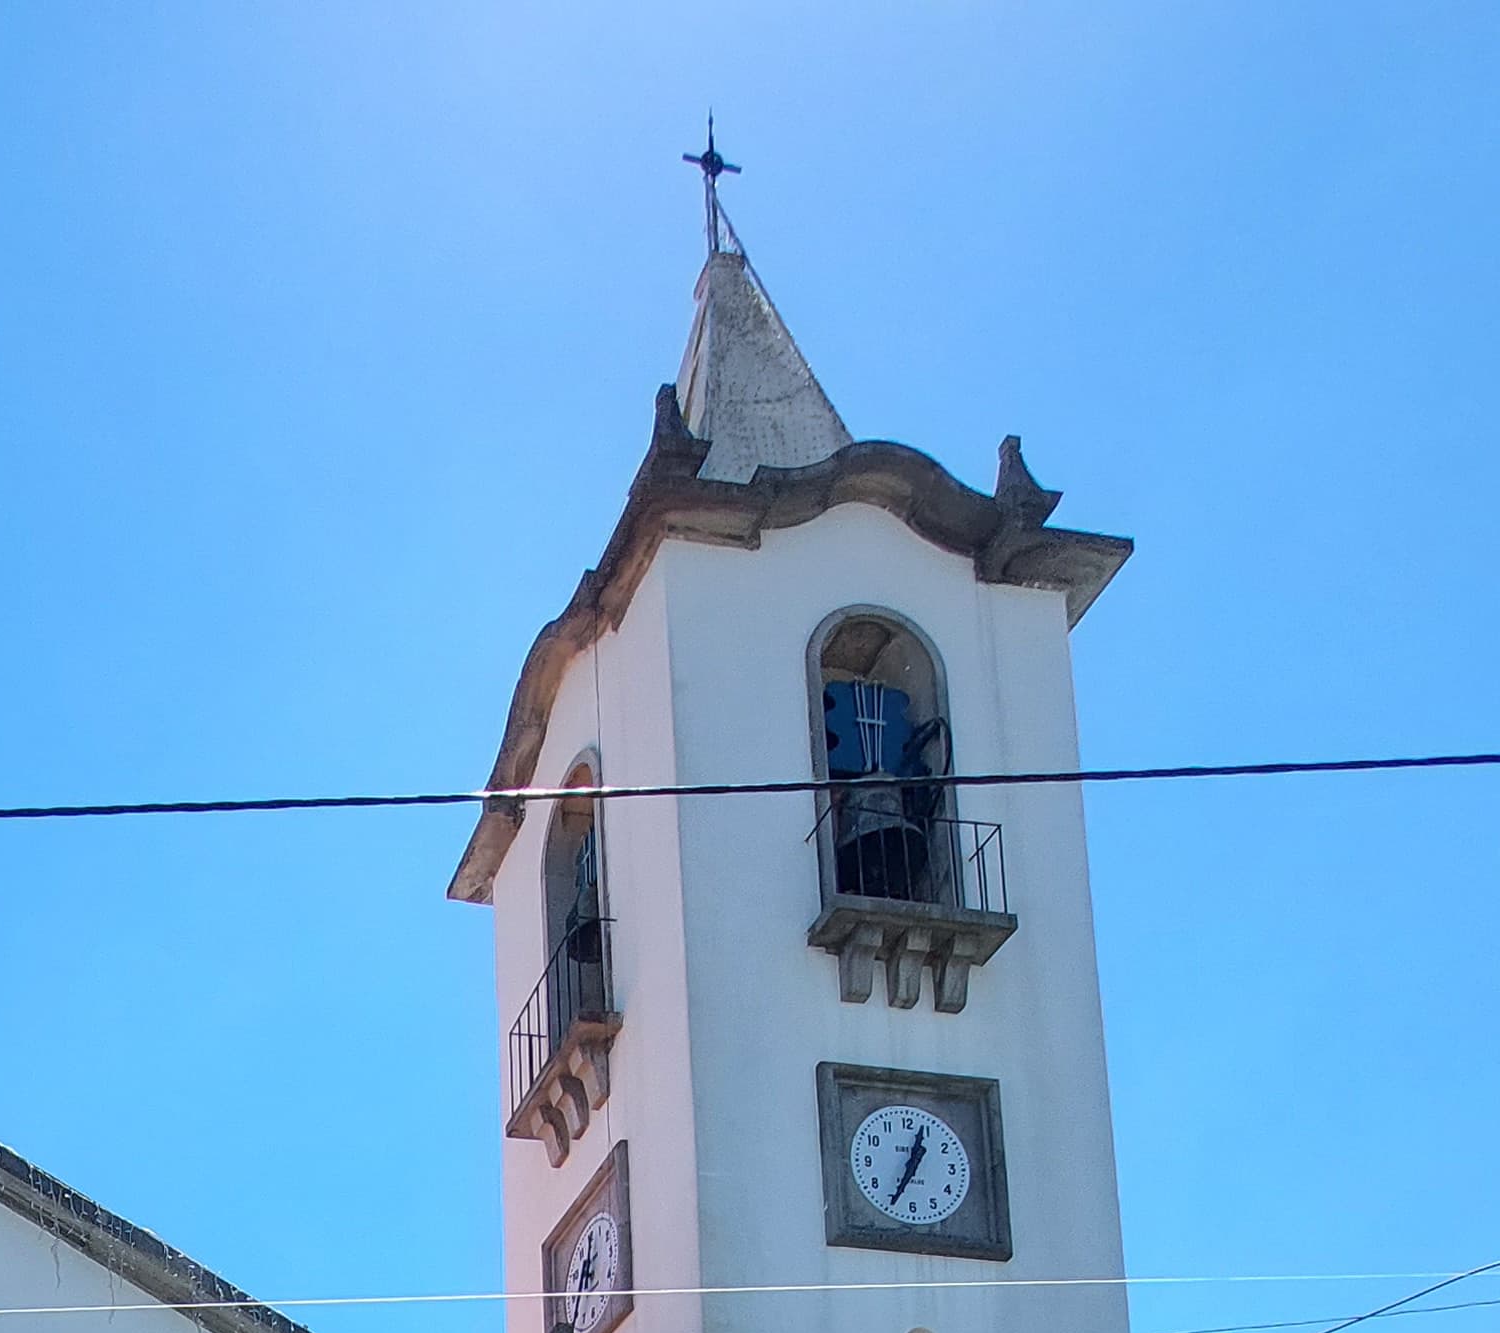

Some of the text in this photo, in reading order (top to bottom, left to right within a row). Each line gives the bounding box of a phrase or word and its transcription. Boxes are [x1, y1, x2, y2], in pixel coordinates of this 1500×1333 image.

[883, 1122, 892, 1134] 11
[902, 1118, 914, 1130] 12
[926, 1126, 931, 1138] 1
[868, 1135, 880, 1147] 10
[940, 1142, 949, 1154] 2
[864, 1156, 872, 1167] 9
[948, 1164, 956, 1175] 3
[871, 1177, 879, 1189] 8
[943, 1184, 952, 1195] 4
[909, 1202, 917, 1213] 6
[929, 1198, 938, 1209] 5
